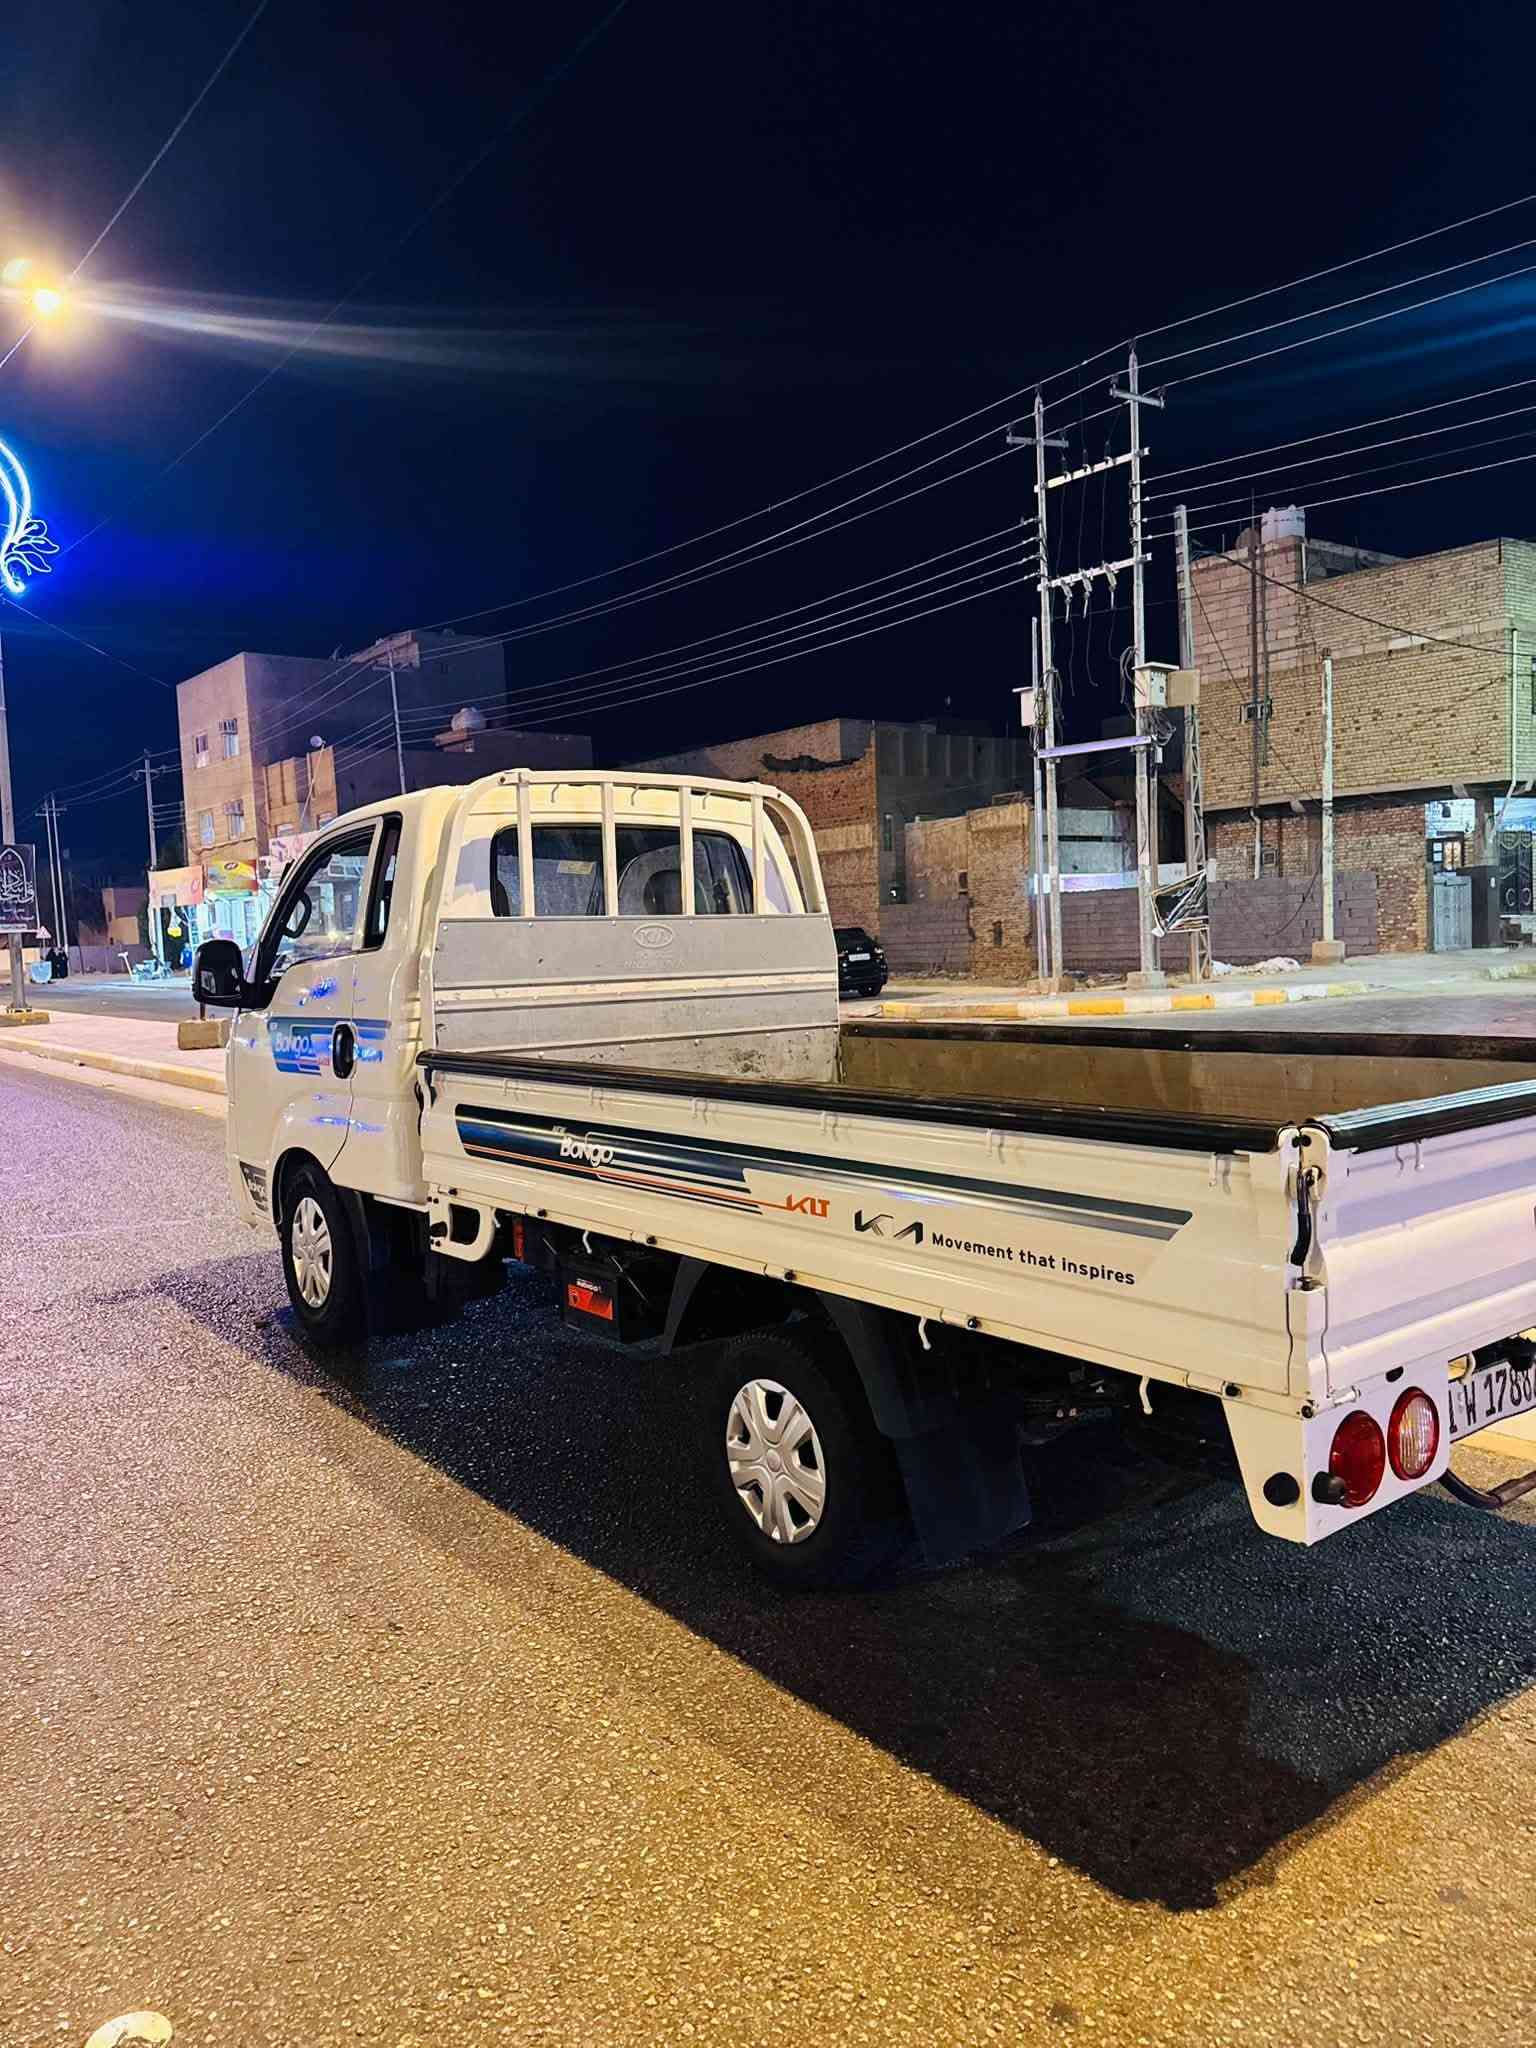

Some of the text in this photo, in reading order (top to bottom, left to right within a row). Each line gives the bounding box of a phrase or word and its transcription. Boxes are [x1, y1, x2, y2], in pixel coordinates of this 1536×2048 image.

[932, 1232, 1136, 1286] Movement that inspires
